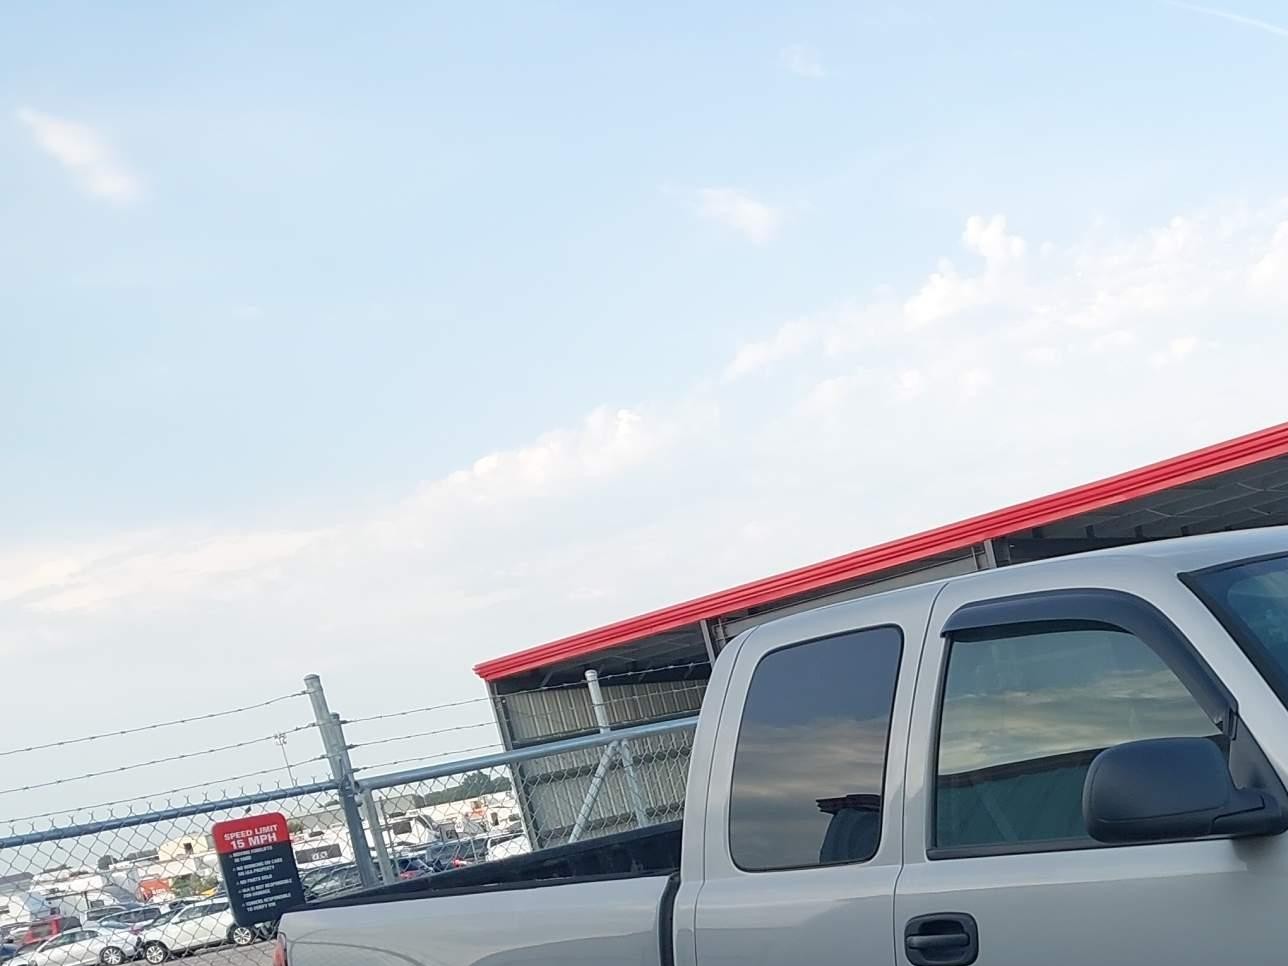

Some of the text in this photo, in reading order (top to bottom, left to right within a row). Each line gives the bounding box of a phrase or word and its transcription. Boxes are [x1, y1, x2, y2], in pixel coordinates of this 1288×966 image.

[224, 824, 278, 841] SPEED LIMIT
[230, 832, 277, 850] 15 MPH
